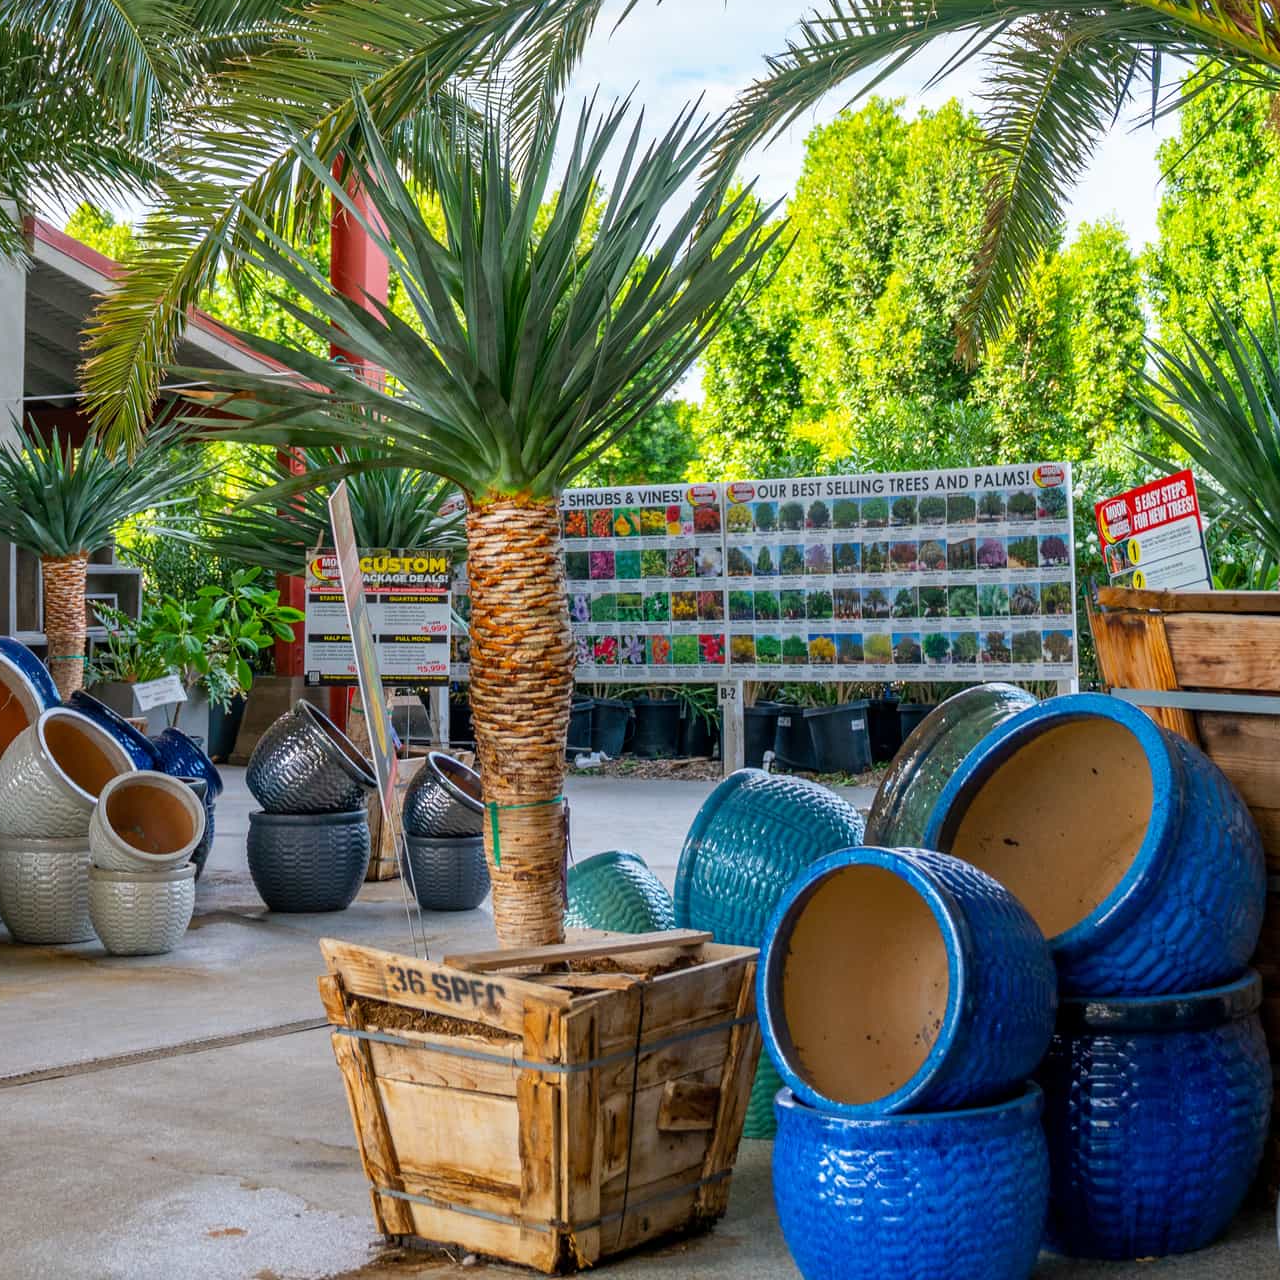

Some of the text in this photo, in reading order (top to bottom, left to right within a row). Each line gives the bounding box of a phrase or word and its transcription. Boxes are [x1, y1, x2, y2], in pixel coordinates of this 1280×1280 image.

[757, 484, 786, 498] OUR
[792, 482, 821, 497] BEST
[826, 479, 884, 496] SELLING
[889, 476, 929, 492] TREES
[934, 474, 969, 490] AND
[974, 471, 1030, 488] PALMS!
[568, 492, 621, 507] SHRUBS
[625, 491, 634, 504] &
[638, 490, 683, 504] VINES!
[1134, 479, 1187, 512] 5 EASY STEPS
[1105, 500, 1127, 521] MOON
[1133, 495, 1195, 531] FOR NEW TREES!
[359, 557, 447, 574] CUSTOM
[362, 574, 449, 583] ACKAGE DEALS!
[721, 687, 736, 700] B-2
[389, 965, 426, 995] 36
